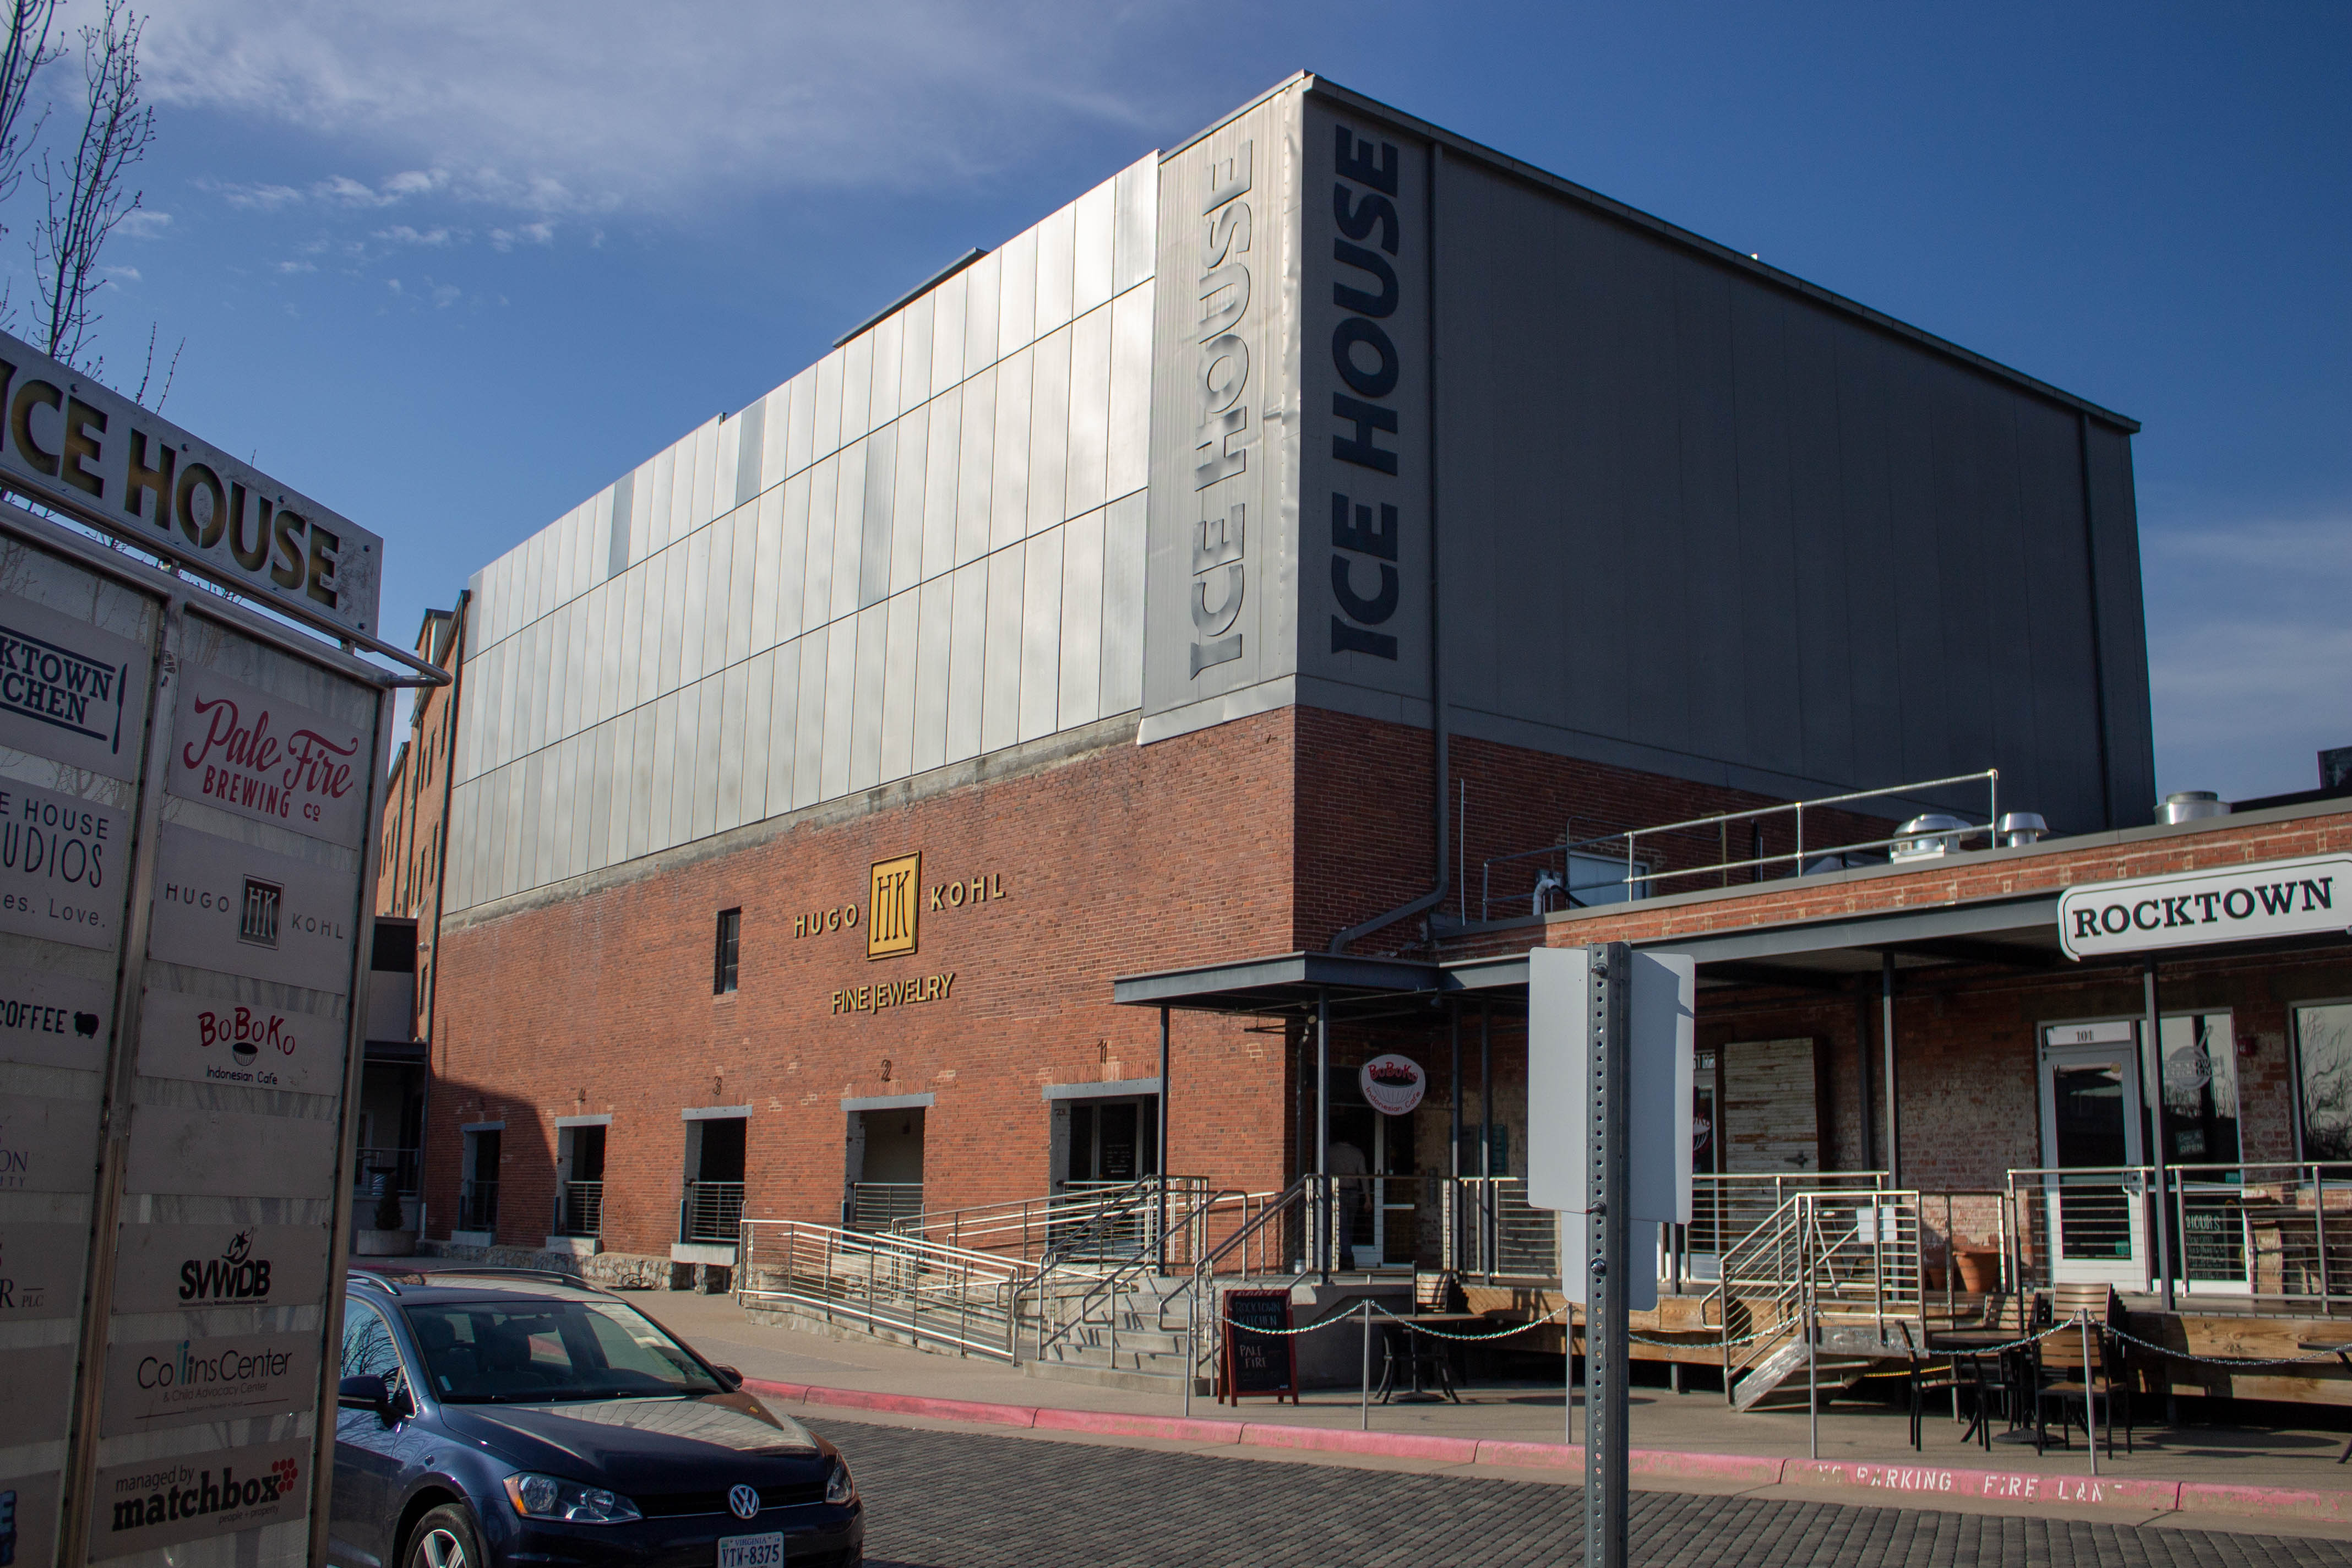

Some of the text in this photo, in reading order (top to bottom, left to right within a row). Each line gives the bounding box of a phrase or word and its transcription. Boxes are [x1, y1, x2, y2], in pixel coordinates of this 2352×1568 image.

[1191, 139, 1252, 679] ICE HOUSE
[1331, 124, 1398, 661] ICE HOUSE
[125, 428, 340, 609] HOUSE
[0, 668, 89, 724] CHEN
[183, 693, 358, 798] Pale Fire
[203, 765, 291, 818] BREWING
[25, 798, 109, 840] HOUSE
[50, 899, 105, 928] Love.
[166, 883, 229, 912] HUGO
[292, 913, 343, 939] KOHL
[794, 904, 858, 939] HUGO
[932, 874, 1005, 911] KOHL
[2072, 877, 2333, 939] ROCKTOWN
[832, 973, 956, 1014] FINE JEWELRY
[2076, 1029, 2092, 1042] 101
[207, 1065, 278, 1085] Indonesian Cafe
[1366, 1086, 1420, 1111] Indonesian Cafe
[179, 1259, 271, 1300] SVWDB
[195, 1384, 239, 1399] Advocacy
[241, 1381, 269, 1394] Center
[112, 1467, 281, 1531] matchbox
[116, 1464, 194, 1493] managed by
[1856, 1466, 1952, 1491] PARKING
[1984, 1475, 2038, 1497] FIRE
[736, 1536, 766, 1547] VIRGINIA
